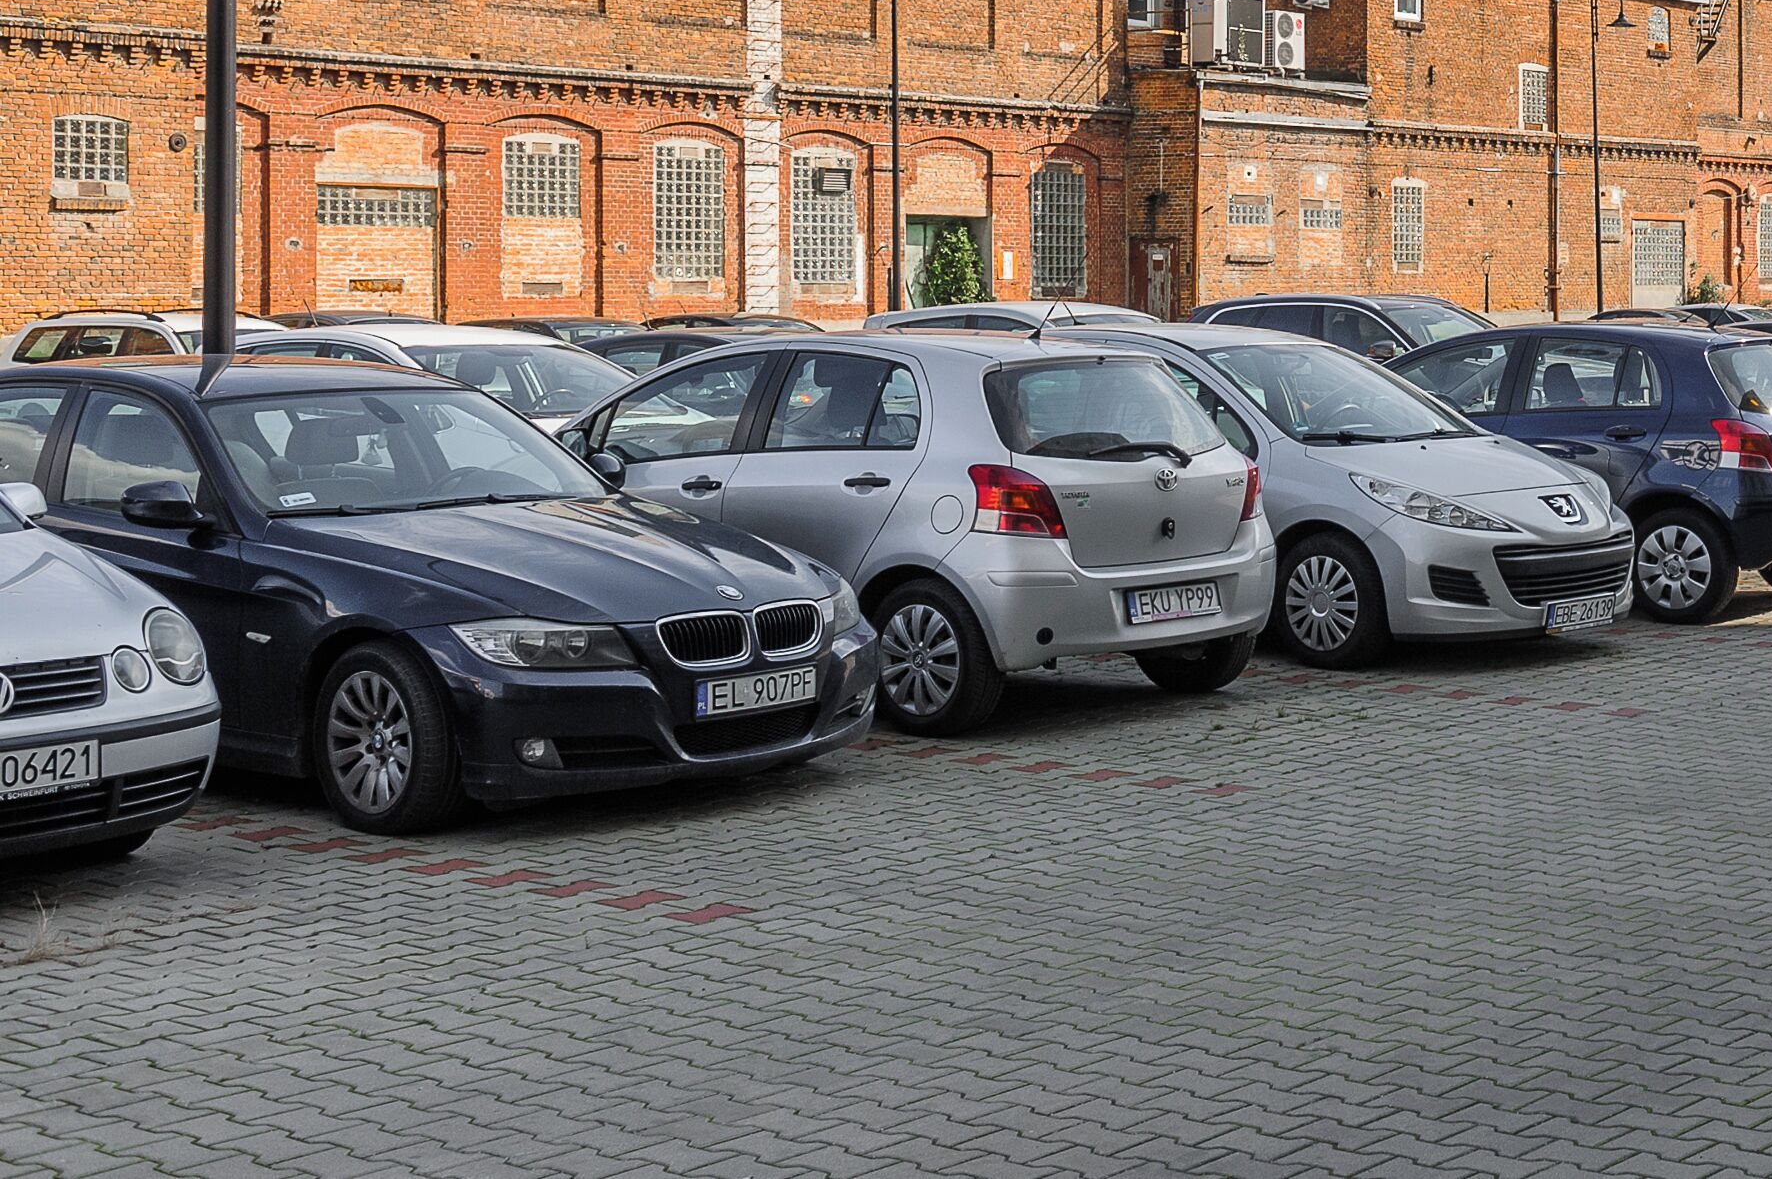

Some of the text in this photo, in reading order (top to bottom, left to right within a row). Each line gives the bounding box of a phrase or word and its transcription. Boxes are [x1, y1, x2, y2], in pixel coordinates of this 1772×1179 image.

[1138, 590, 1171, 615] EKU
[1175, 585, 1214, 611] YP99
[1555, 598, 1613, 625] EBE 26139
[712, 669, 814, 711] EL 907PF
[697, 702, 707, 711] PL
[1, 744, 92, 788] 06421
